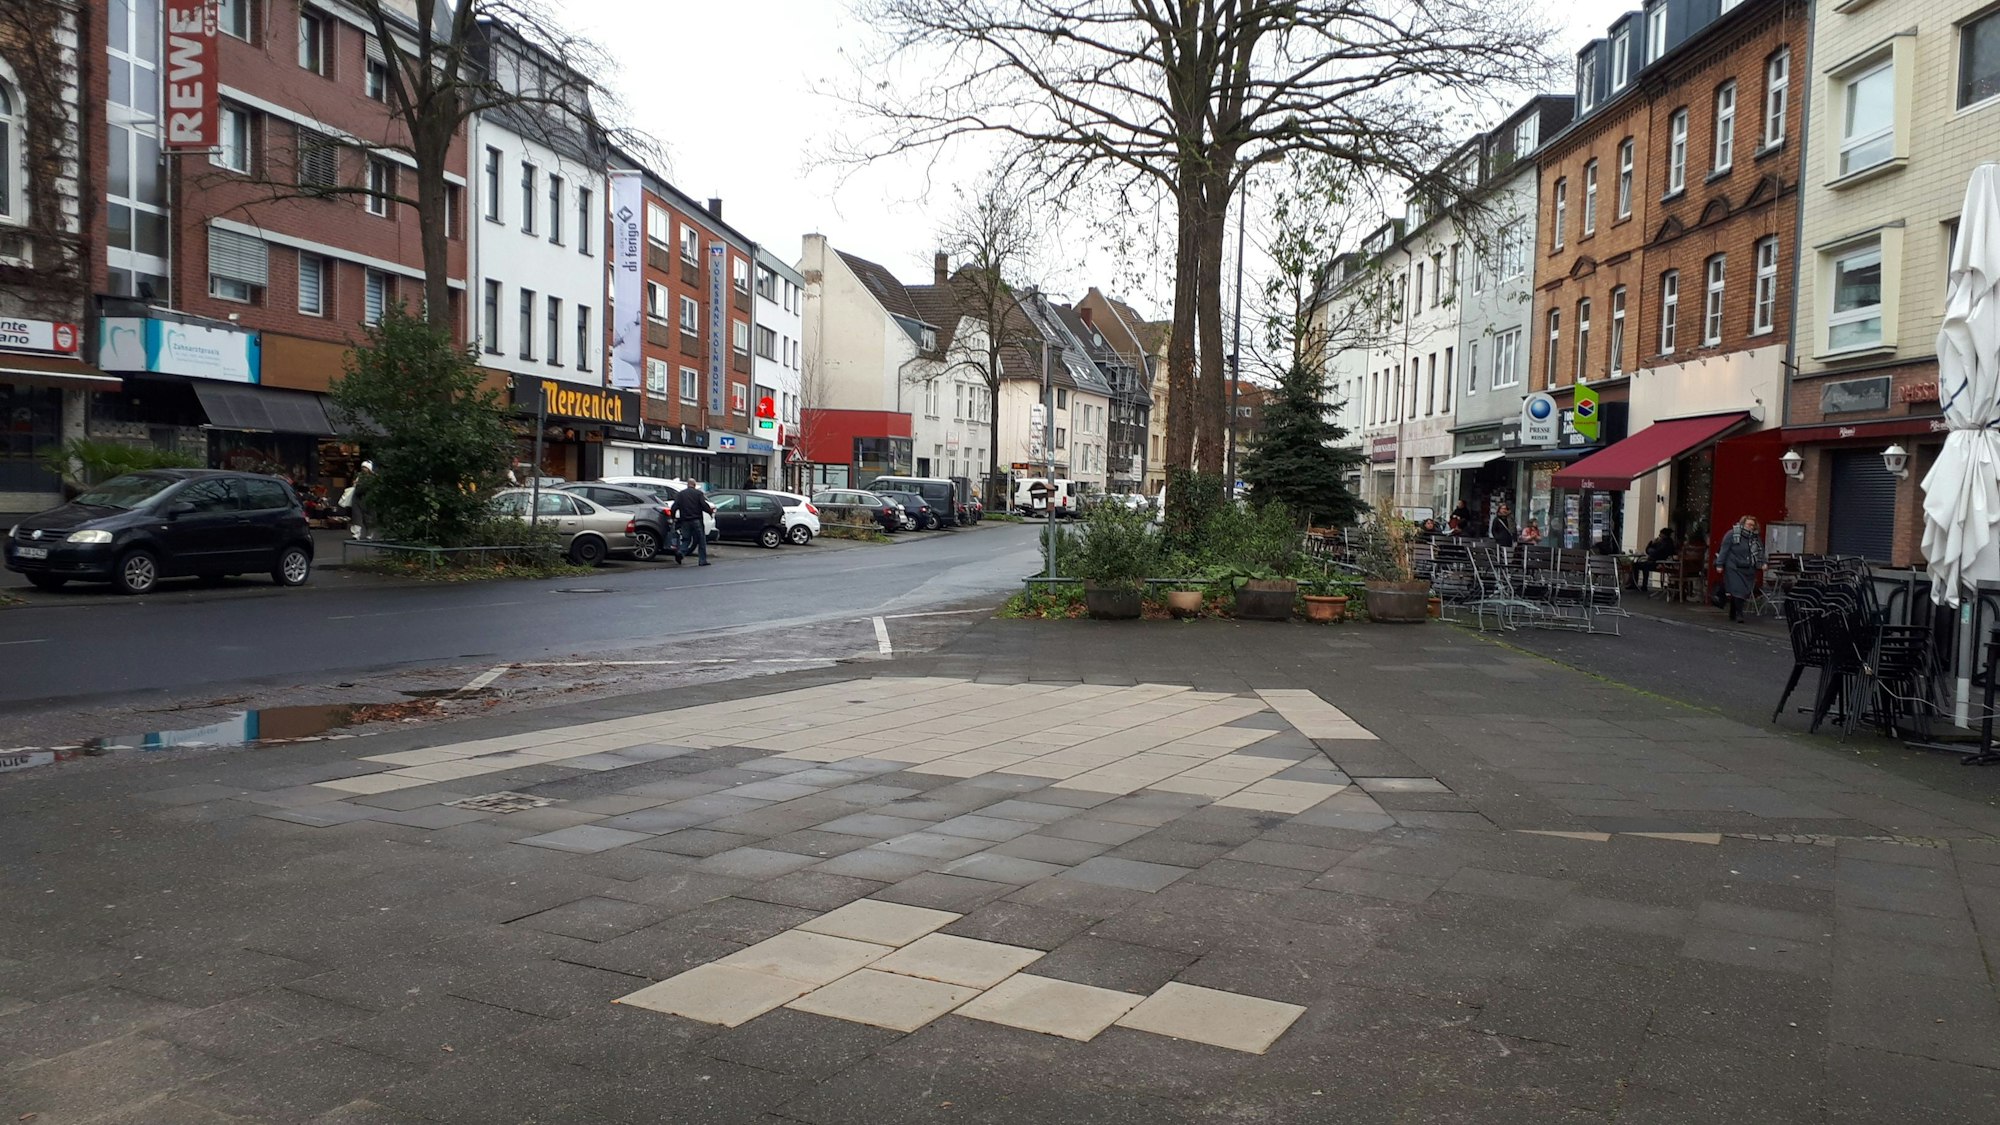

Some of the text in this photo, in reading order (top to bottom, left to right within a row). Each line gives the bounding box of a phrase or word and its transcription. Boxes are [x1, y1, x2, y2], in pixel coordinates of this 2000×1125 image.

[169, 7, 203, 142] REWE
[622, 222, 639, 272] di ferigo
[173, 342, 220, 356] Zahnarztpraxis
[542, 380, 622, 422] Merzenich
